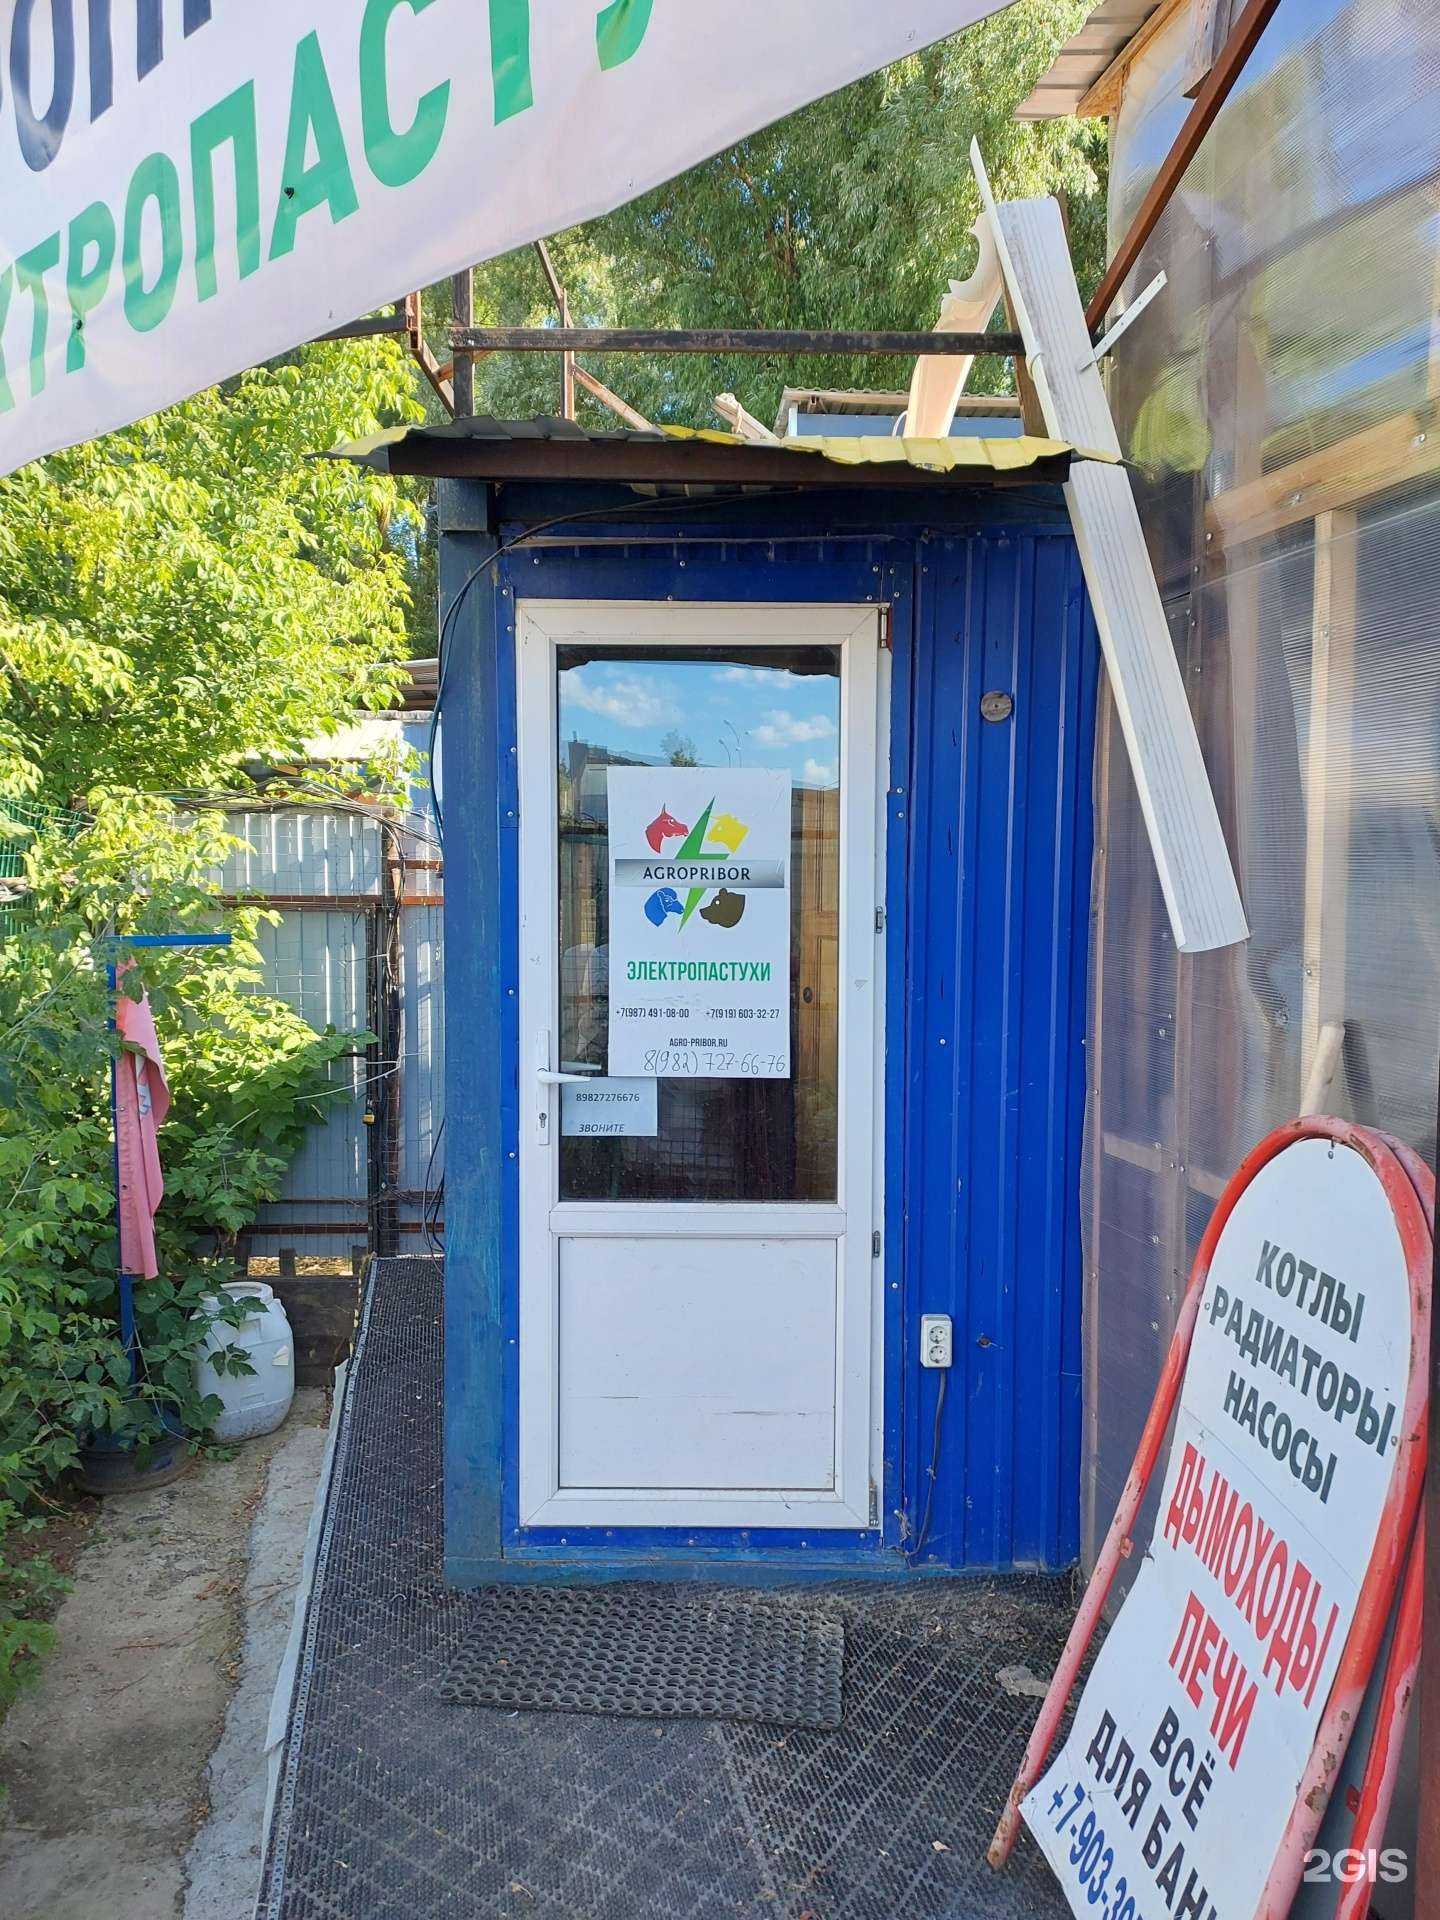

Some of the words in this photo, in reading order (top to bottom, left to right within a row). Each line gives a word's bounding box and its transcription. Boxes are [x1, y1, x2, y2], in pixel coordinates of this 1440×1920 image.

[643, 866, 751, 881] AGROPRIBOR
[627, 961, 771, 982] ЭЛЕКТРОПАСТУХИ
[616, 1007, 646, 1018] +7(987)
[648, 1007, 690, 1018] 491-08-00
[706, 1008, 737, 1019] +7(919)
[738, 1008, 780, 1019] 603-32-27
[669, 1038, 728, 1047] AGRO-PRIBOR.RU
[703, 1052, 786, 1075] 727-66-76
[576, 1093, 640, 1102] 89827276676
[578, 1123, 625, 1133] ЗВОНИТЕ
[1255, 1240, 1366, 1344] КОТЛЫ
[1209, 1285, 1397, 1457] РАДИАТОРЫ
[1222, 1370, 1338, 1504] НАСОСЫ
[1163, 1440, 1340, 1711] ДЫМОХОДЫ
[1168, 1590, 1259, 1772] ПЕЧИ
[1149, 1705, 1216, 1832] ВСЁ
[1085, 1709, 1152, 1831] ДЛЯ
[1141, 1803, 1218, 1920] БАН
